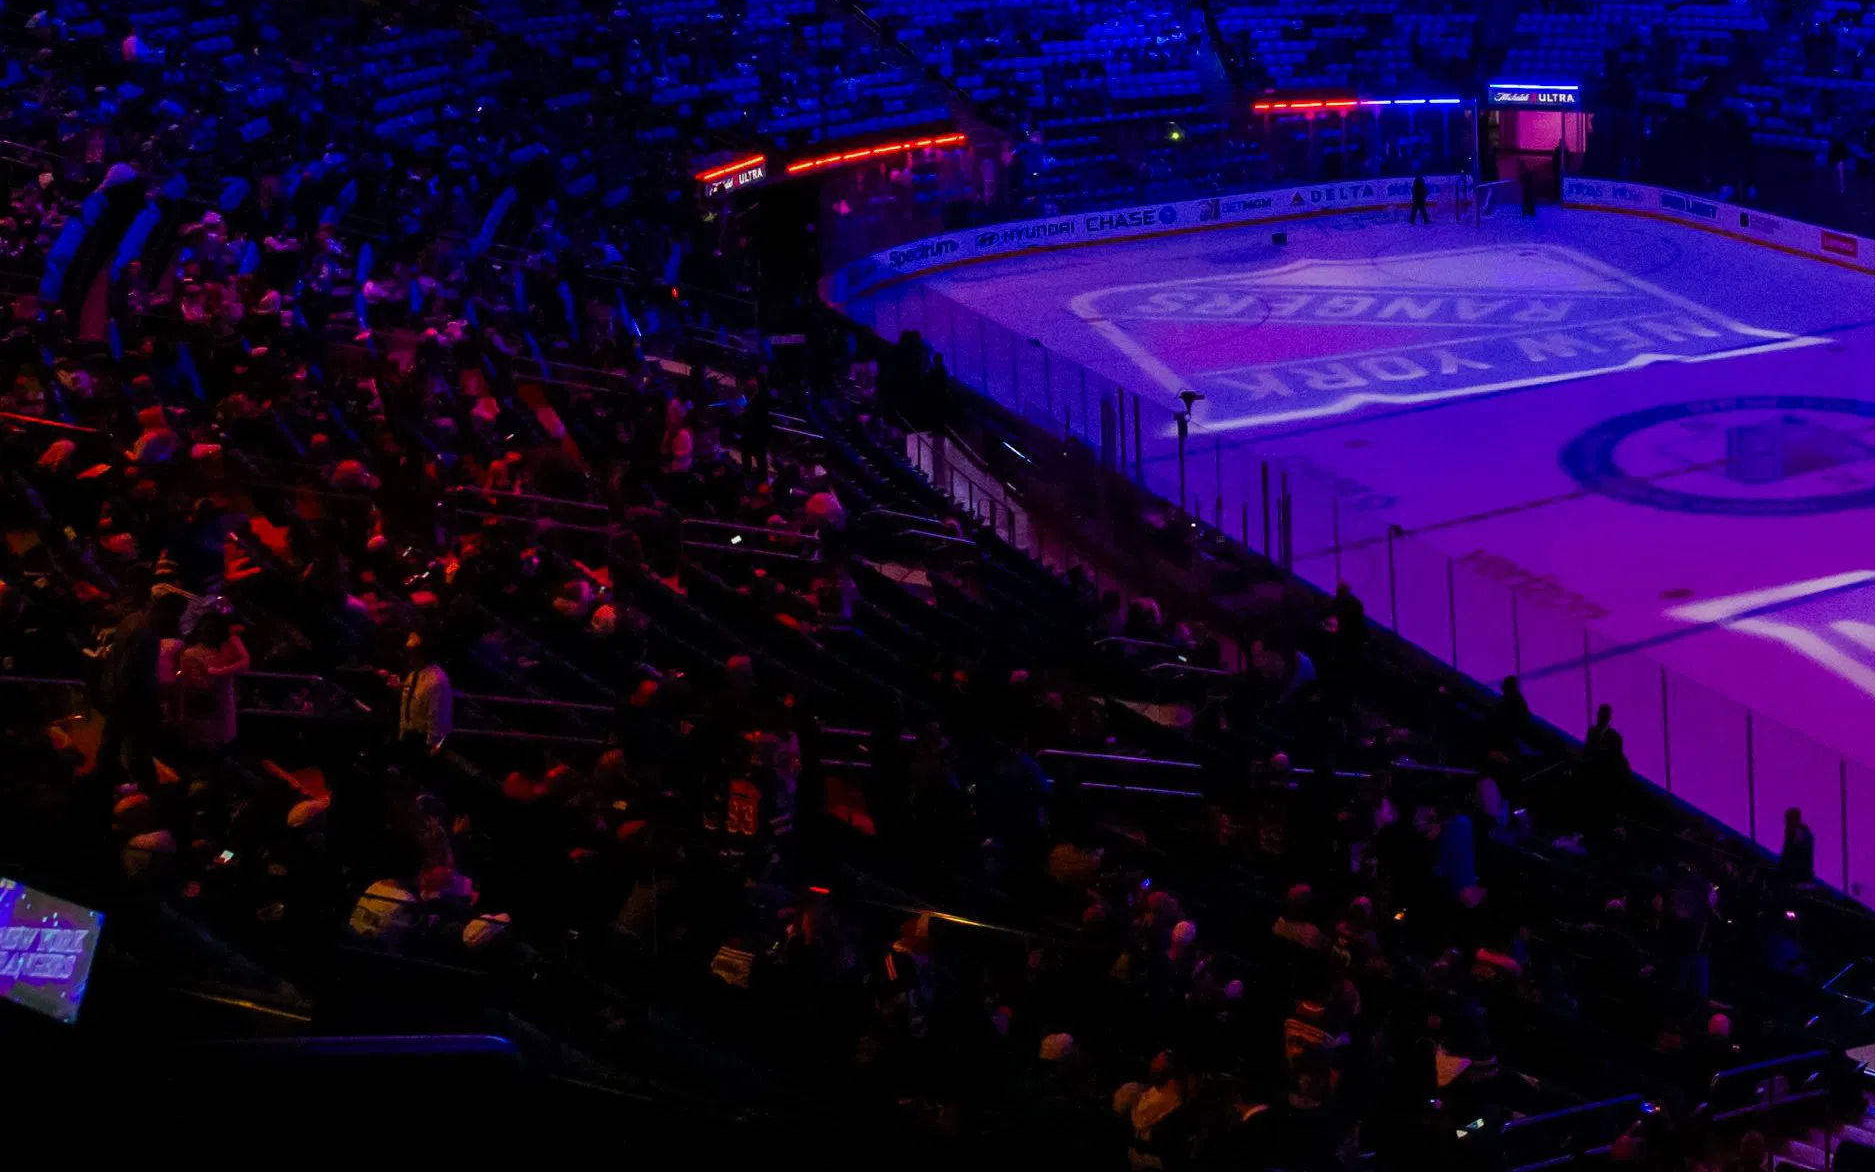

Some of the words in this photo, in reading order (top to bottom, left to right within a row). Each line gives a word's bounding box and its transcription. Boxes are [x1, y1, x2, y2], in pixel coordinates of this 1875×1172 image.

[1538, 93, 1576, 103] ULTRA
[739, 167, 763, 185] ULTRA
[1310, 185, 1375, 204] DELTA
[1085, 209, 1156, 233] CHASE
[1003, 221, 1075, 243] HYUNDAI
[889, 238, 952, 269] Spectrum
